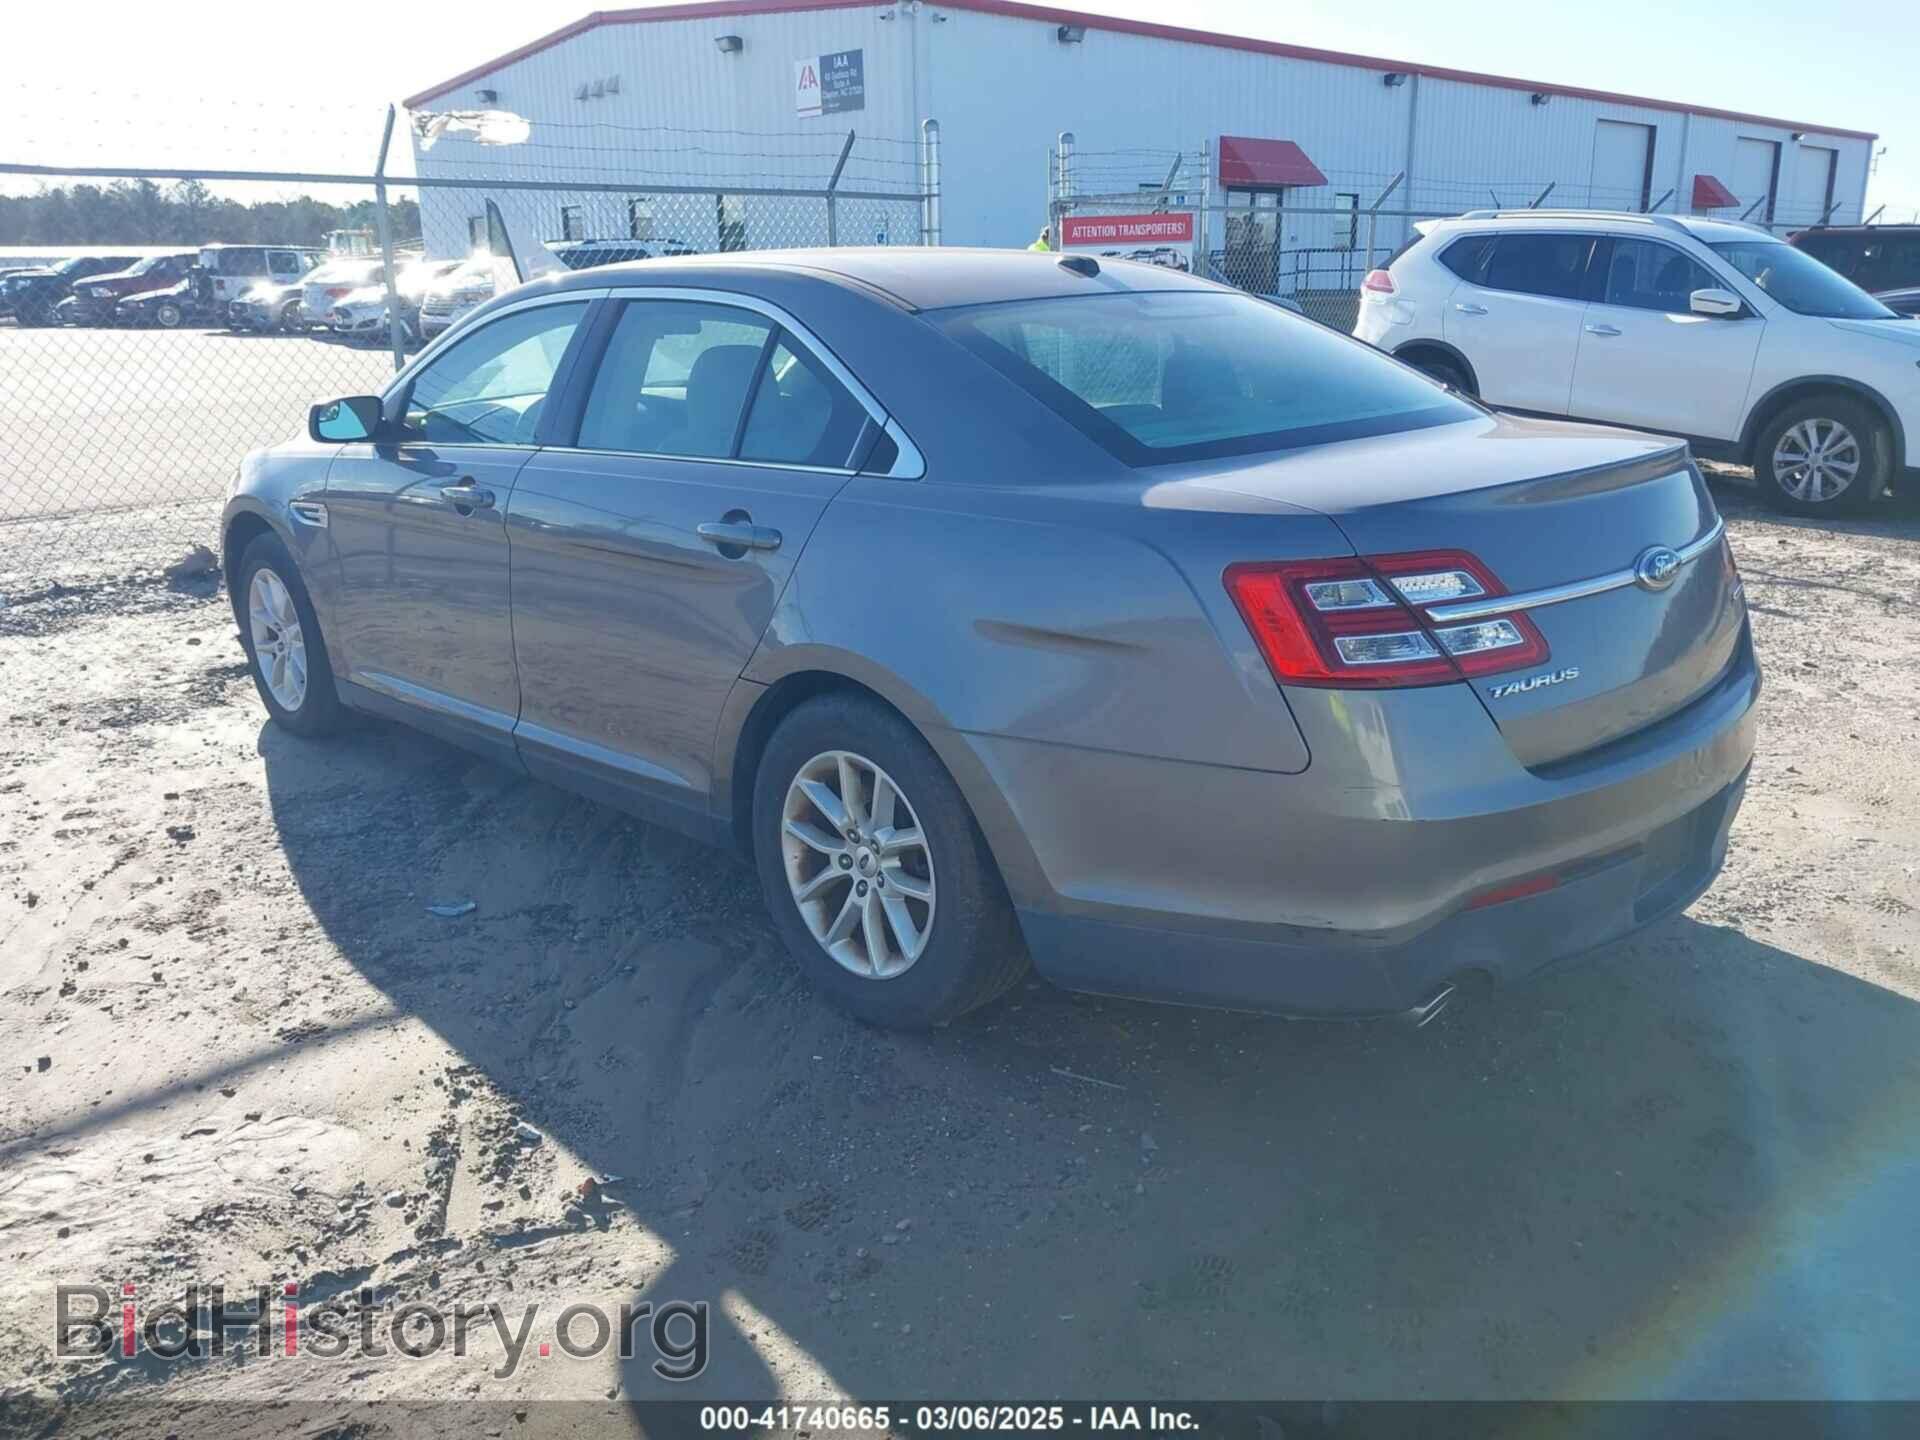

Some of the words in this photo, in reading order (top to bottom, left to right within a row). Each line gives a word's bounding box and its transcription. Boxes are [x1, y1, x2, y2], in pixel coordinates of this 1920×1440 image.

[1072, 224, 1117, 238] ATTENTION
[1119, 222, 1186, 236] TRANSPORTERS!
[1490, 667, 1580, 699] TAURUS
